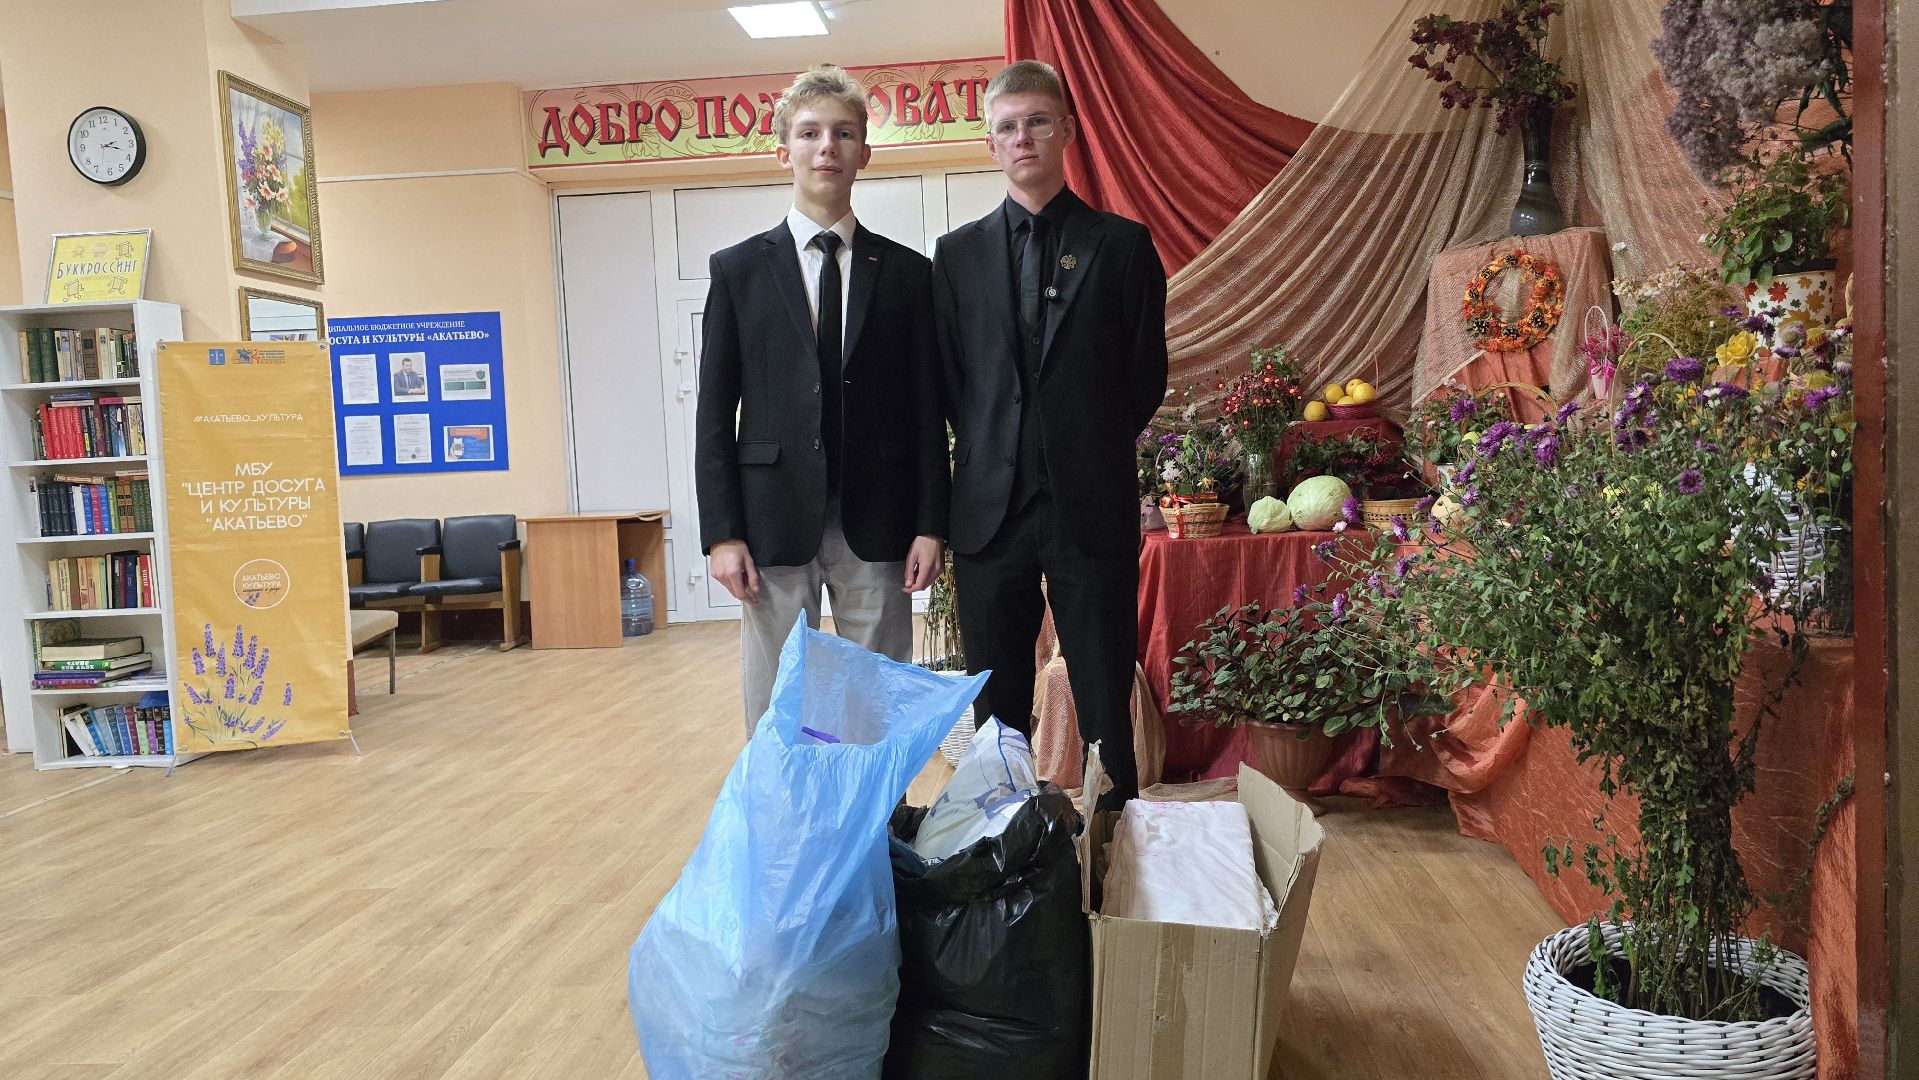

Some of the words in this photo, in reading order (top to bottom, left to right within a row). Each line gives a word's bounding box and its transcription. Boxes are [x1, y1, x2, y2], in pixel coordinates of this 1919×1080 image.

[88, 120, 96, 128] 11
[99, 116, 108, 124] 12
[122, 126, 129, 135] 2
[538, 98, 682, 158] ДОБРО
[80, 129, 89, 138] 10
[80, 143, 86, 152] 9
[128, 140, 134, 148] 3
[85, 157, 91, 165] 8
[126, 154, 131, 162] 4
[94, 165, 99, 173] 7
[107, 167, 113, 176] 6
[118, 163, 124, 172] 5
[57, 260, 138, 279] БУККРОССИНГ
[370, 322, 415, 331] БЮДЖЕТНОЕ
[416, 320, 465, 329] УЧРЕЖДЕНИЕ
[328, 334, 360, 346] ОСУГА
[362, 334, 370, 344] И
[372, 332, 425, 344] КУЛЬТУРЫ
[427, 330, 489, 342] «АКАТЬЕВО»
[235, 462, 273, 477] МБУ
[182, 481, 245, 498] "ЦЕНТР
[252, 477, 325, 497] ДОСУГА
[201, 499, 213, 514] И
[220, 496, 311, 513] КУЛЬТУРЫ
[206, 514, 308, 532] "АКАТЬЕВО"
[242, 573, 281, 581] АКАТЬЕВО
[242, 581, 282, 589] КУЛЬТУРА
